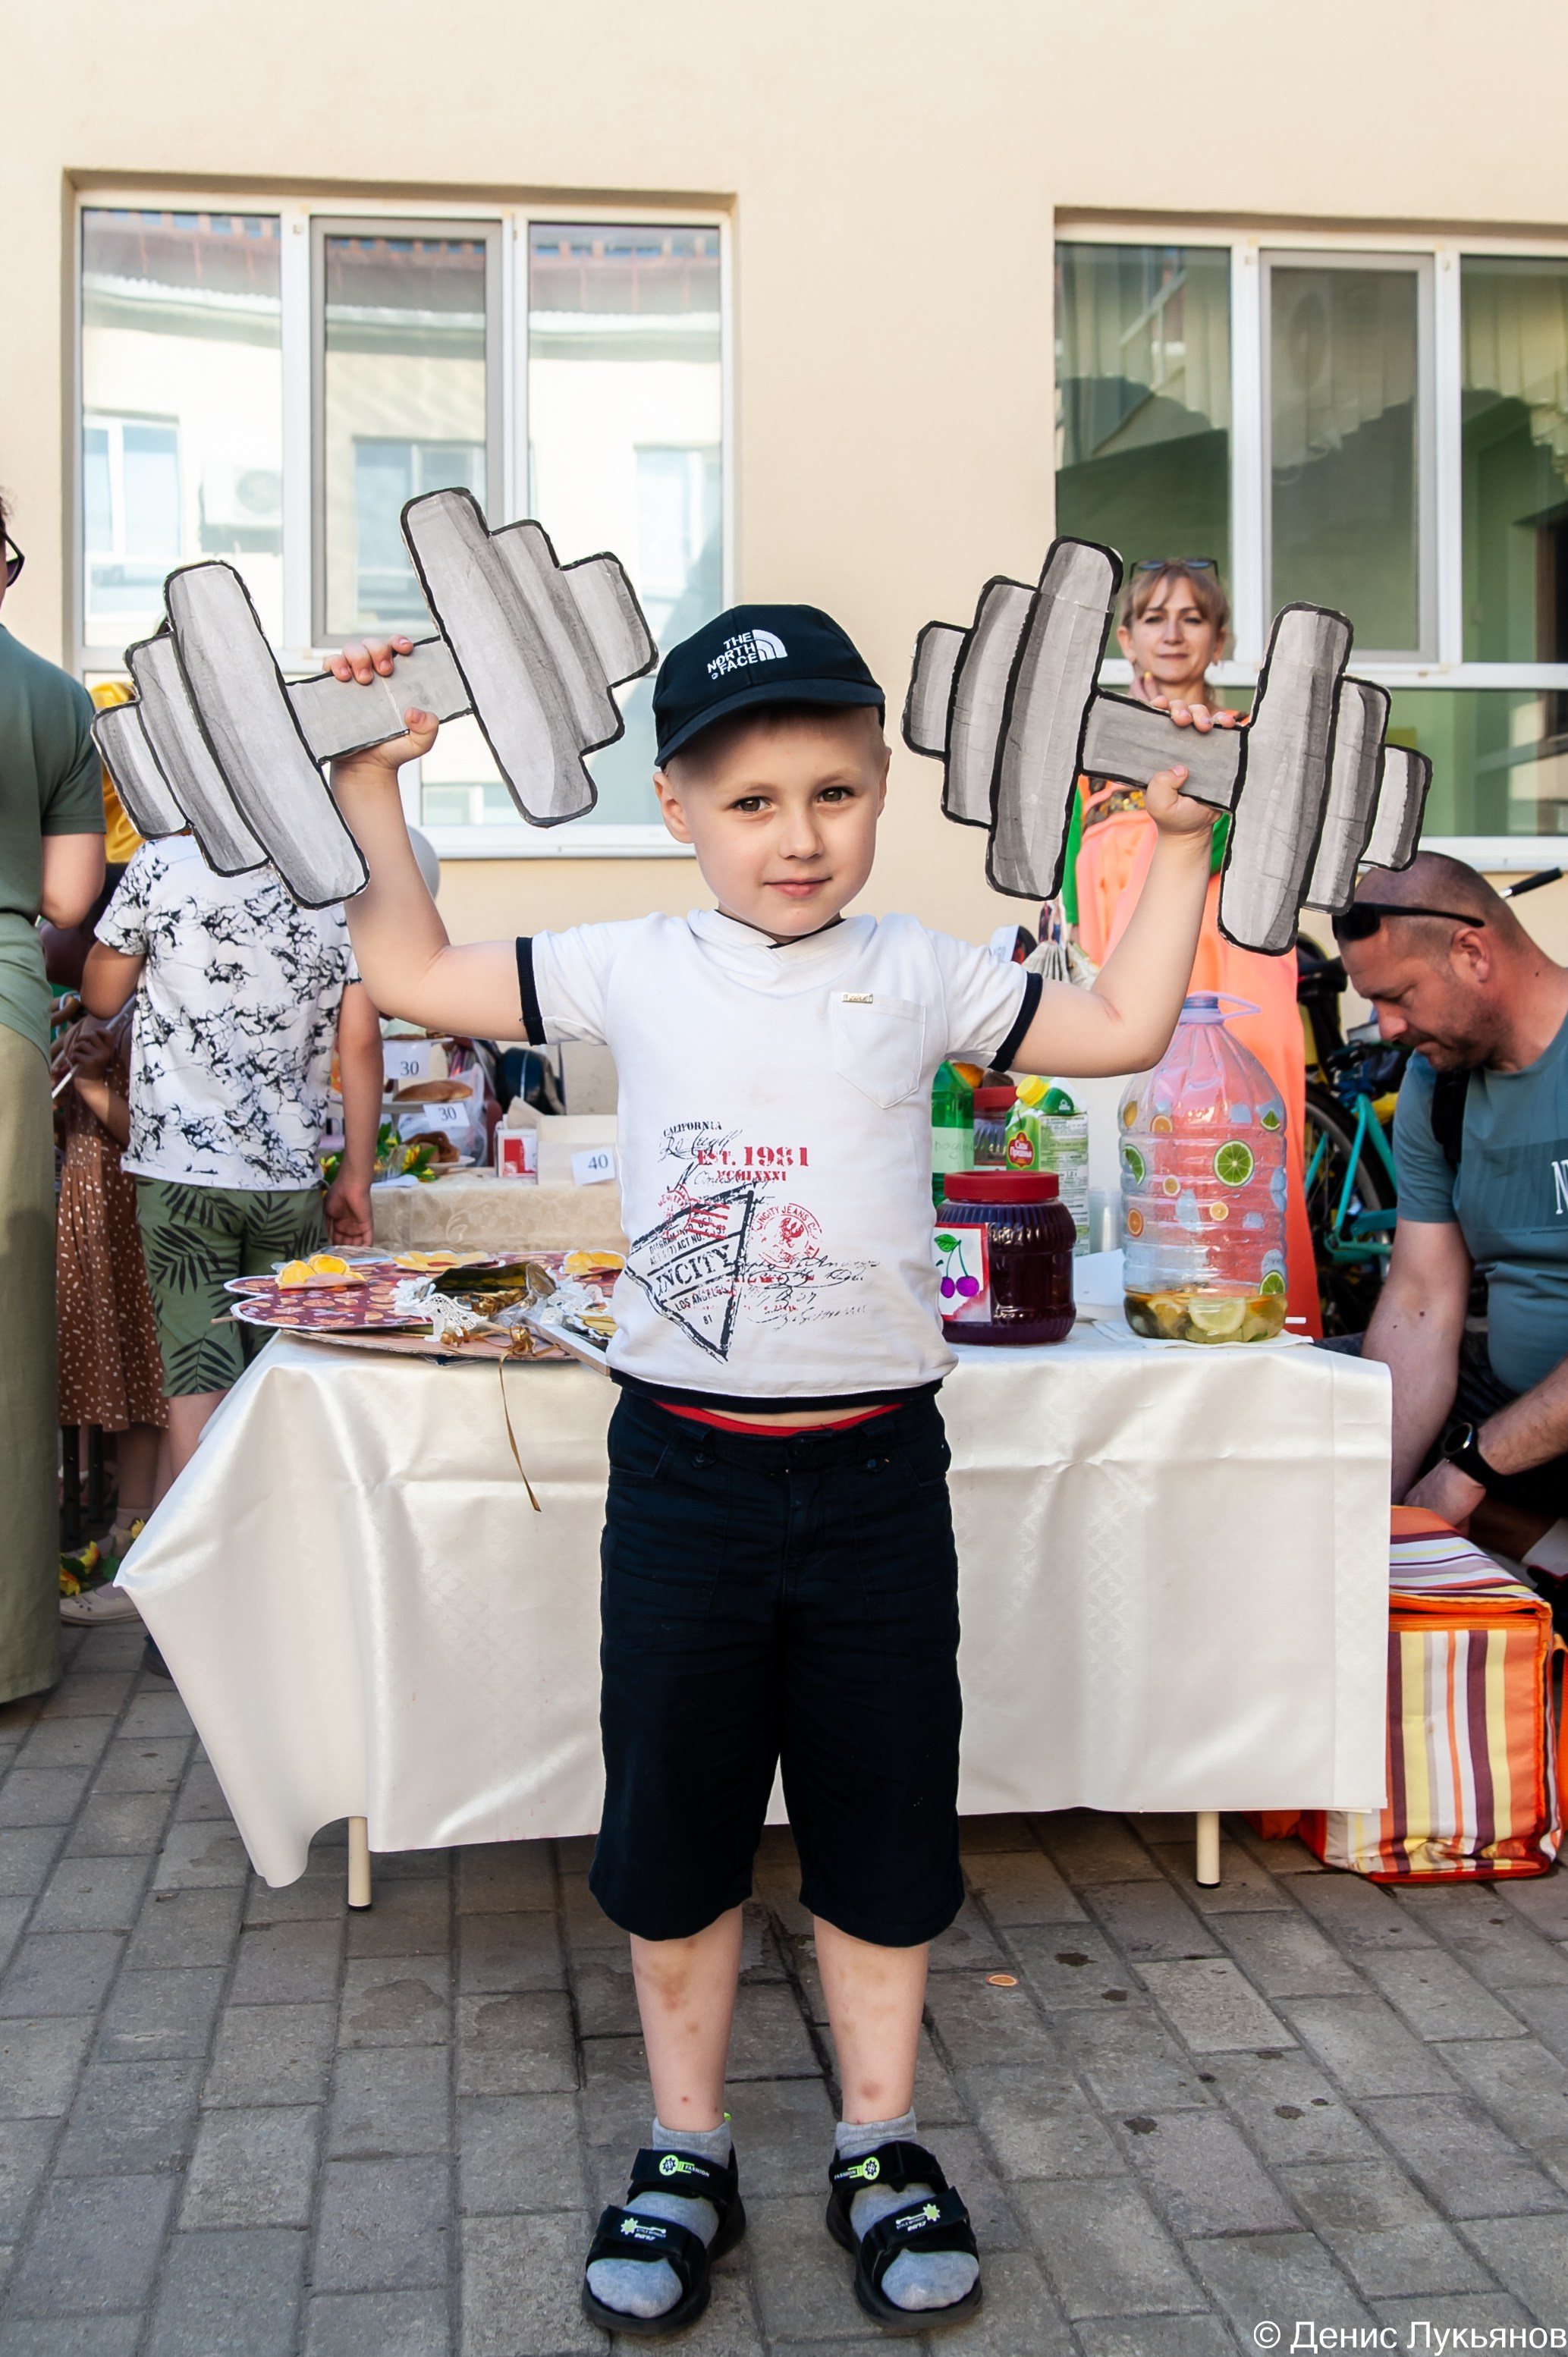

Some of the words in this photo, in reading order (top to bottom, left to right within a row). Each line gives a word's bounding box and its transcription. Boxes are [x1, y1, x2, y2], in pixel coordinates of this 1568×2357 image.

[723, 632, 752, 649] THE
[707, 642, 756, 674] NORTH
[720, 652, 759, 675] FACE
[400, 1061, 419, 1076] 30
[440, 1106, 457, 1120] 30
[663, 1120, 722, 1137] CALIFORNIA
[588, 1153, 608, 1170] 40
[743, 1146, 809, 1167] 1981
[781, 1205, 809, 1221] JEANS
[677, 1237, 690, 1251] ACT
[674, 1296, 691, 1312] LOS
[702, 1314, 713, 1325] 81
[685, 2165, 709, 2177] FASHION
